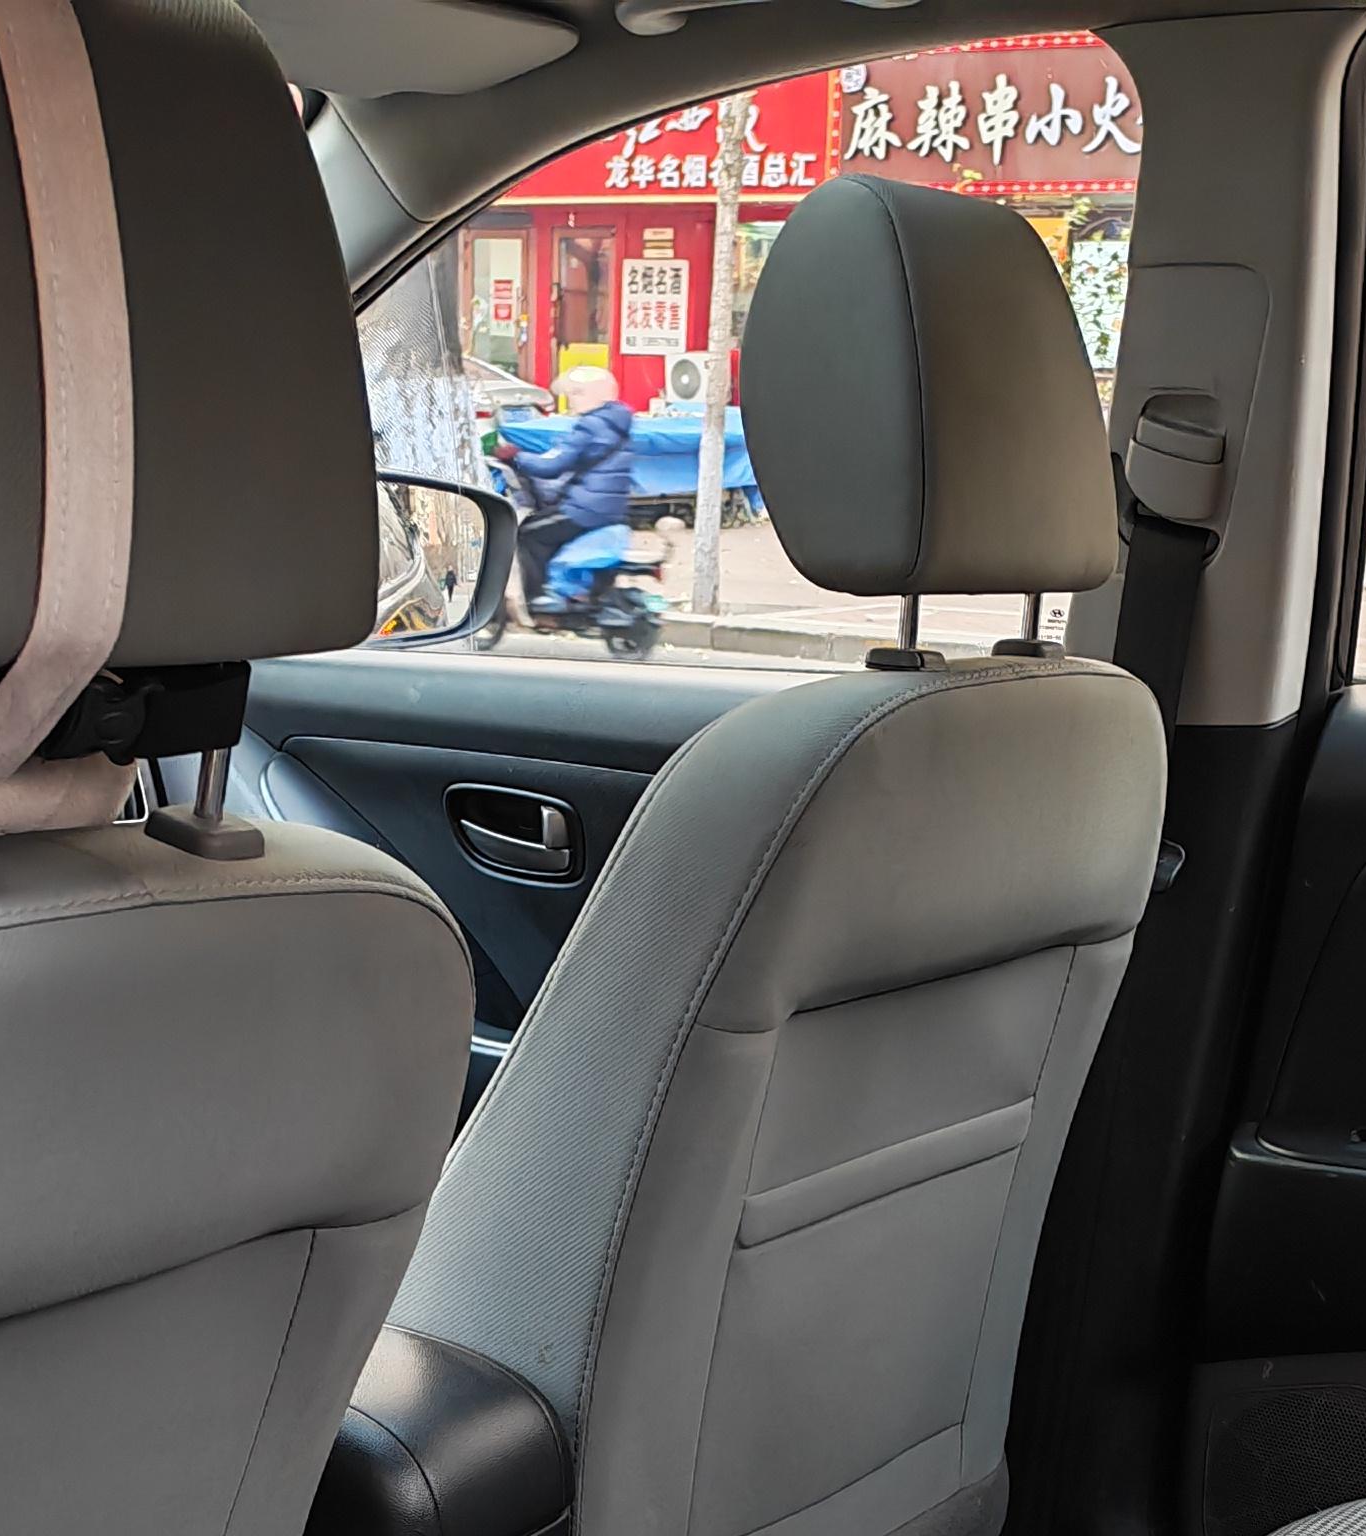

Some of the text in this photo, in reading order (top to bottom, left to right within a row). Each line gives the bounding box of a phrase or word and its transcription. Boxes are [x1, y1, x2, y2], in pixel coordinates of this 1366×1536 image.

[843, 73, 1142, 166] 麻辣串小火
[627, 266, 682, 295] 名烟名酒
[626, 301, 681, 330] 批发零售
